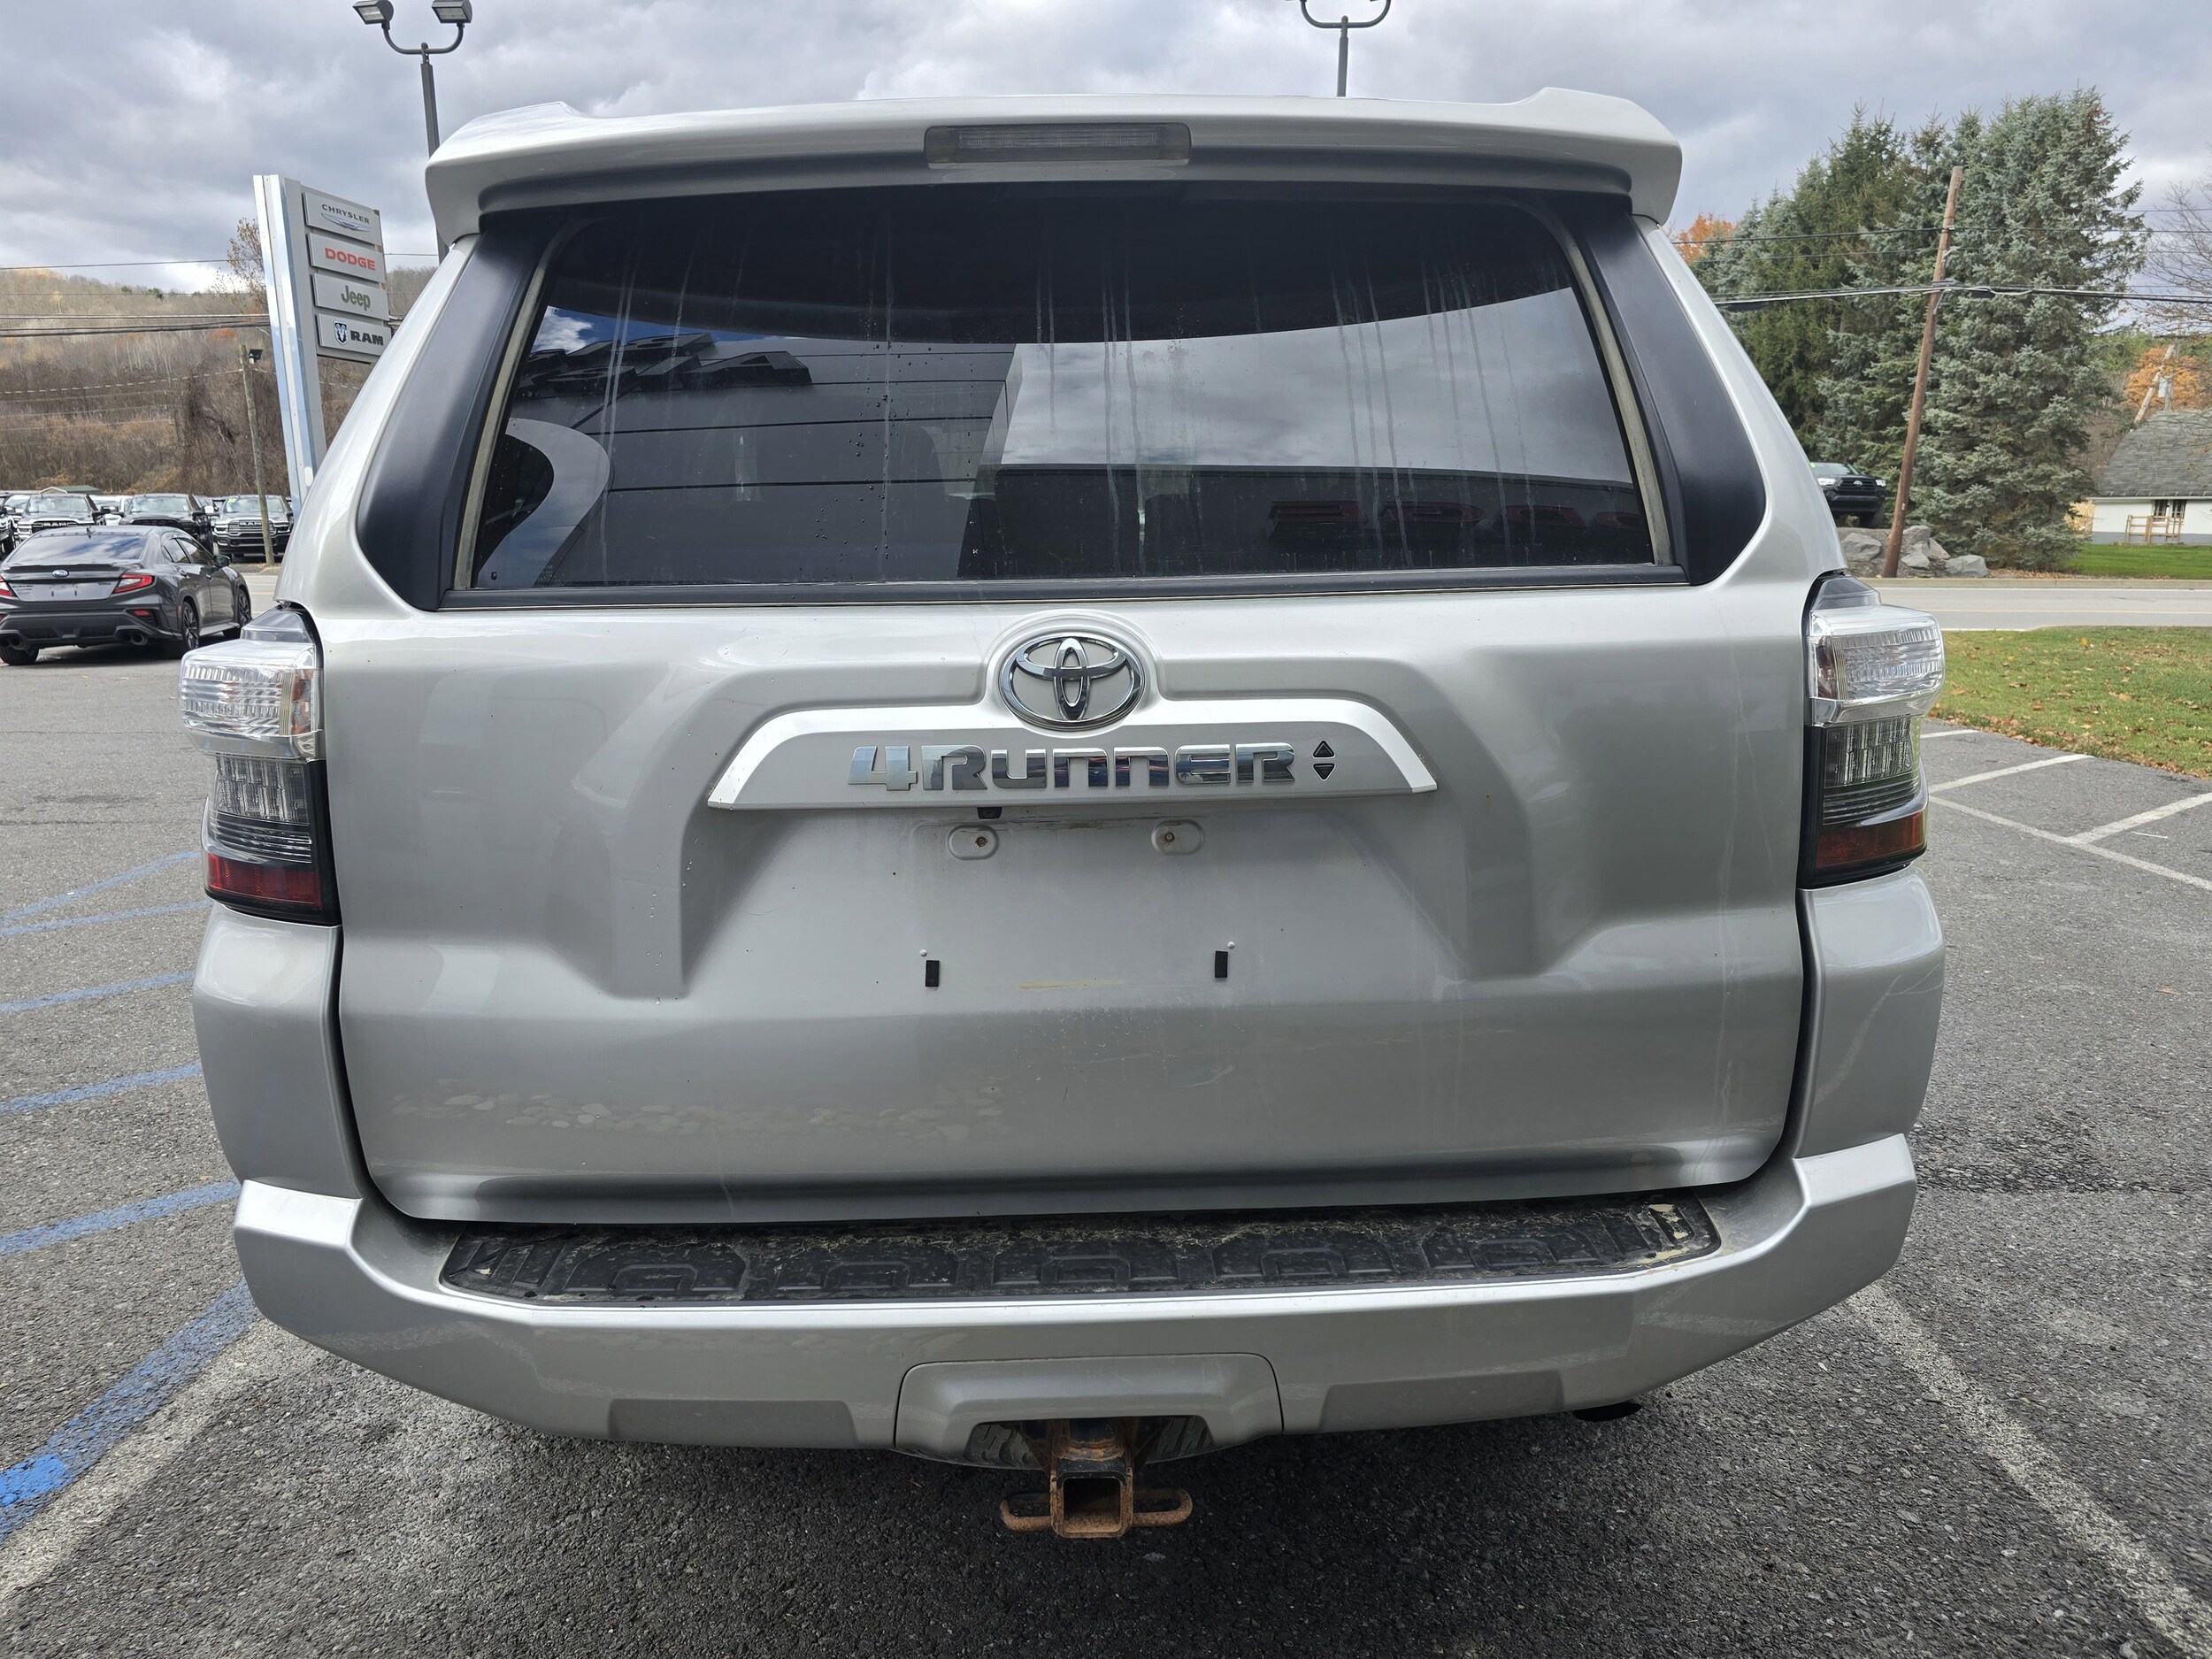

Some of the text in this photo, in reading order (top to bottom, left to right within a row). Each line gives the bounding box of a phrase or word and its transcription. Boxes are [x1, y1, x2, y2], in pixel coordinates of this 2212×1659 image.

[322, 204, 370, 224] CHRYSLER
[325, 248, 376, 270] DODGE
[341, 285, 371, 311] Jeep
[350, 330, 384, 346] RAM
